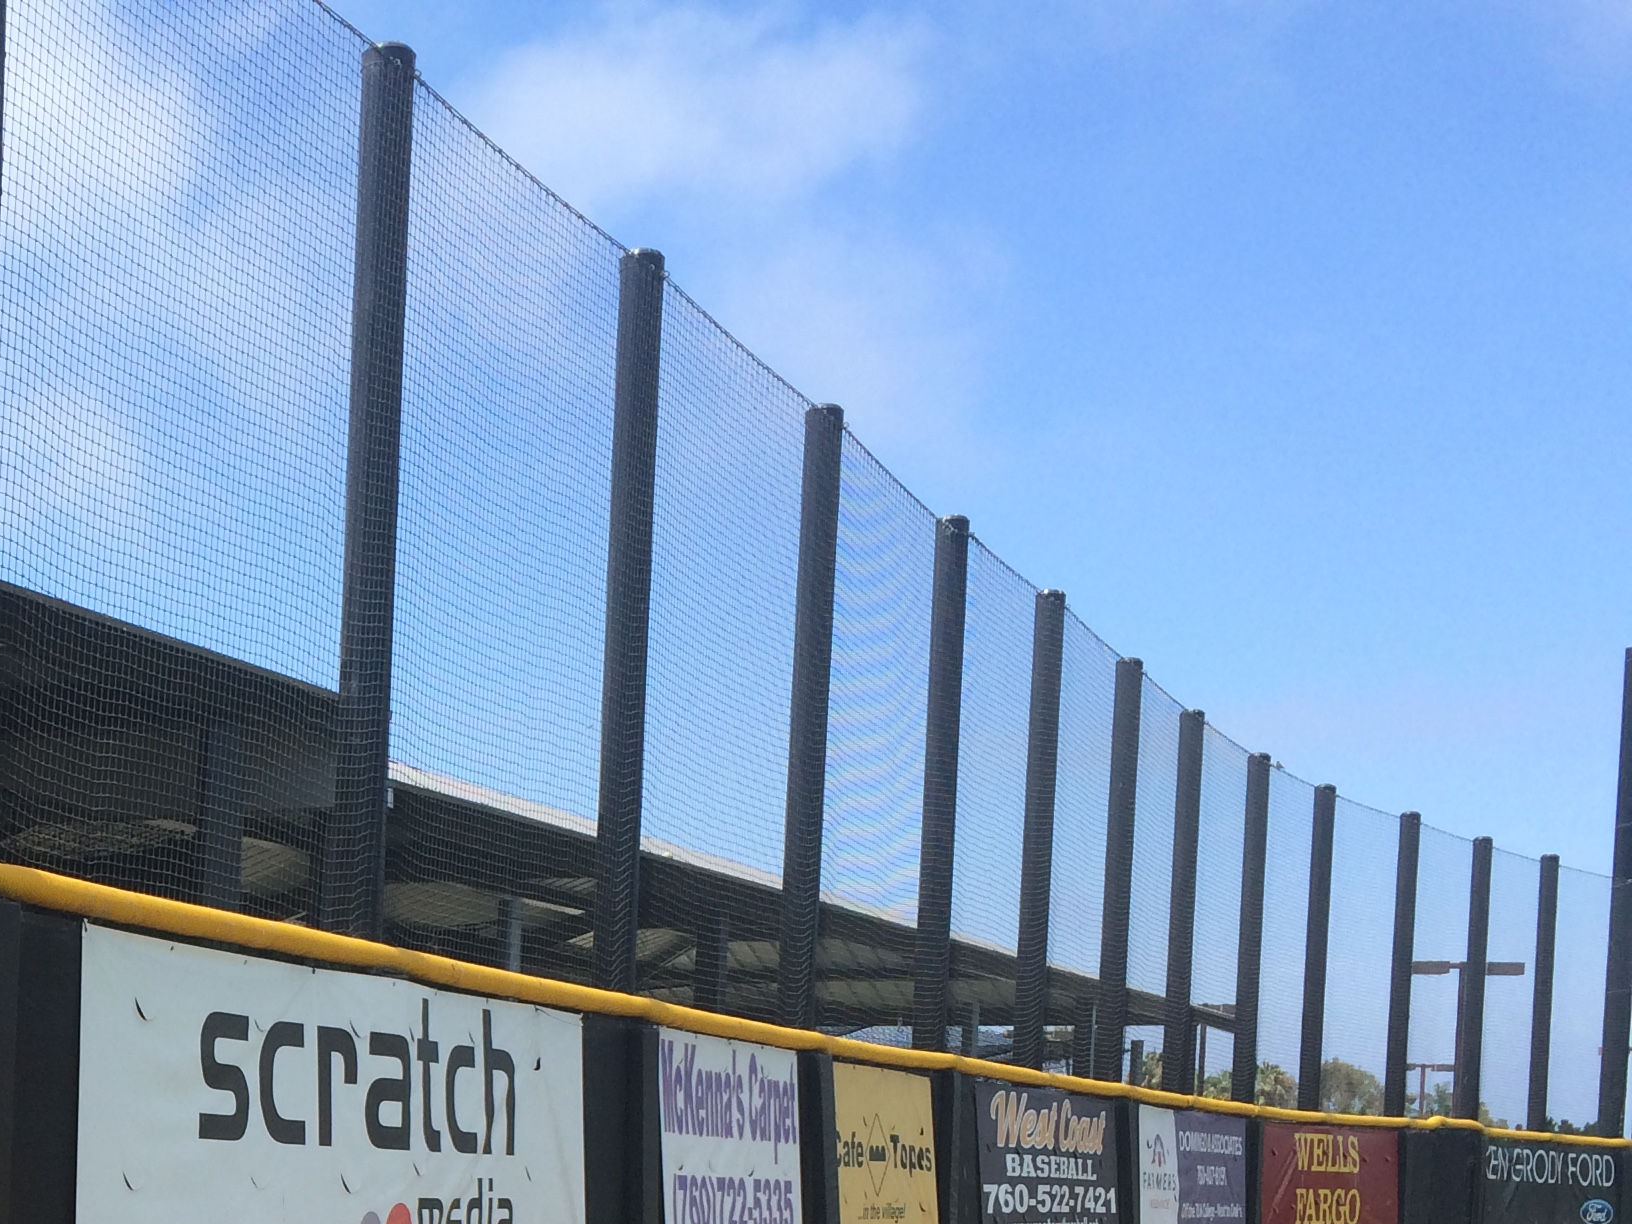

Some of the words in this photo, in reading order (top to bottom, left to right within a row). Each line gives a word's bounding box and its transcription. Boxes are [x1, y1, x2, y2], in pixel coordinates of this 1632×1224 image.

[198, 997, 516, 1156] scratch
[660, 1038, 745, 1142] McKenna's
[748, 1052, 797, 1165] Carpet
[989, 1090, 1058, 1150] West
[1059, 1098, 1106, 1156] Coast
[889, 1134, 932, 1178] Topes
[1005, 1153, 1097, 1181] BASEBALL
[1293, 1132, 1360, 1174] WELLS
[1511, 1149, 1564, 1184] GRODY
[1568, 1153, 1615, 1187] FORD
[983, 1183, 1117, 1215] 760-522-7421
[1586, 1203, 1608, 1223] Ford
